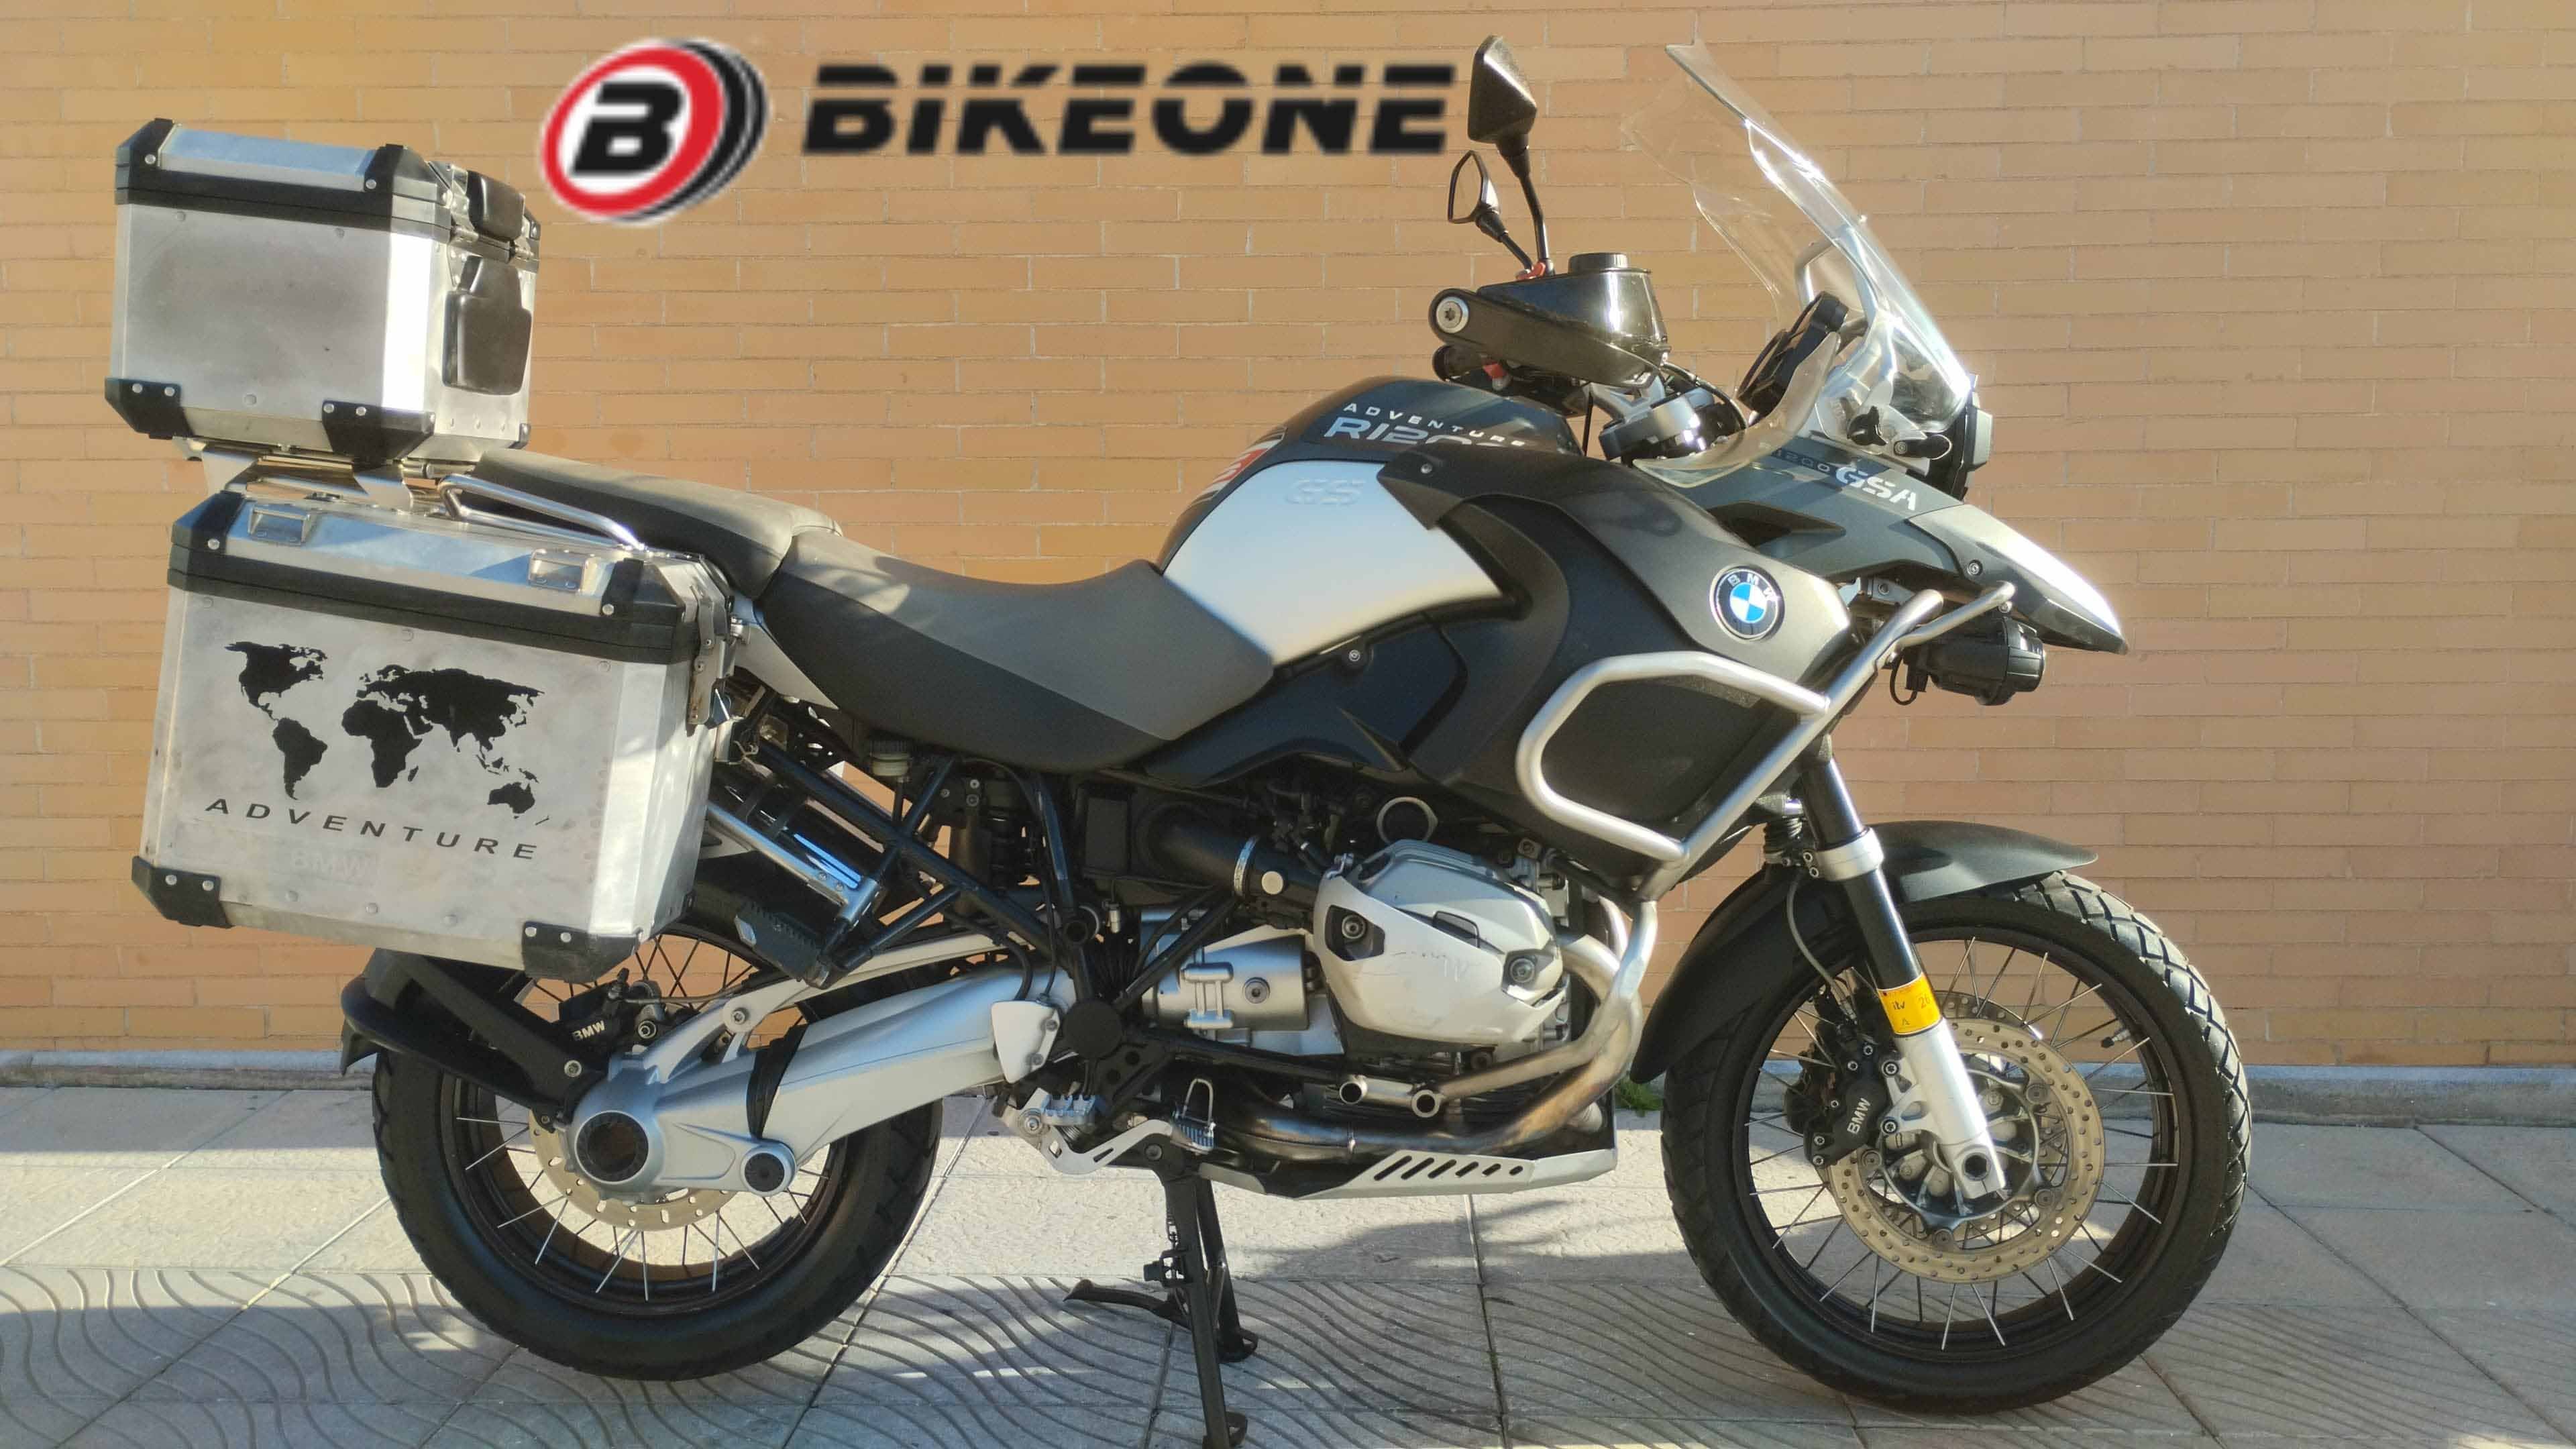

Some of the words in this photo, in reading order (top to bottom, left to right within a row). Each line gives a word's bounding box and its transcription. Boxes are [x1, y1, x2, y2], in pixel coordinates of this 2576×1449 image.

[1343, 402, 1525, 447] ADVENTURE
[1835, 466, 1917, 511] GSA
[1727, 572, 1779, 602] BMW
[205, 798, 538, 860] ADVENTURE
[572, 1020, 605, 1040] BMW
[1846, 1097, 1871, 1134] BMW
